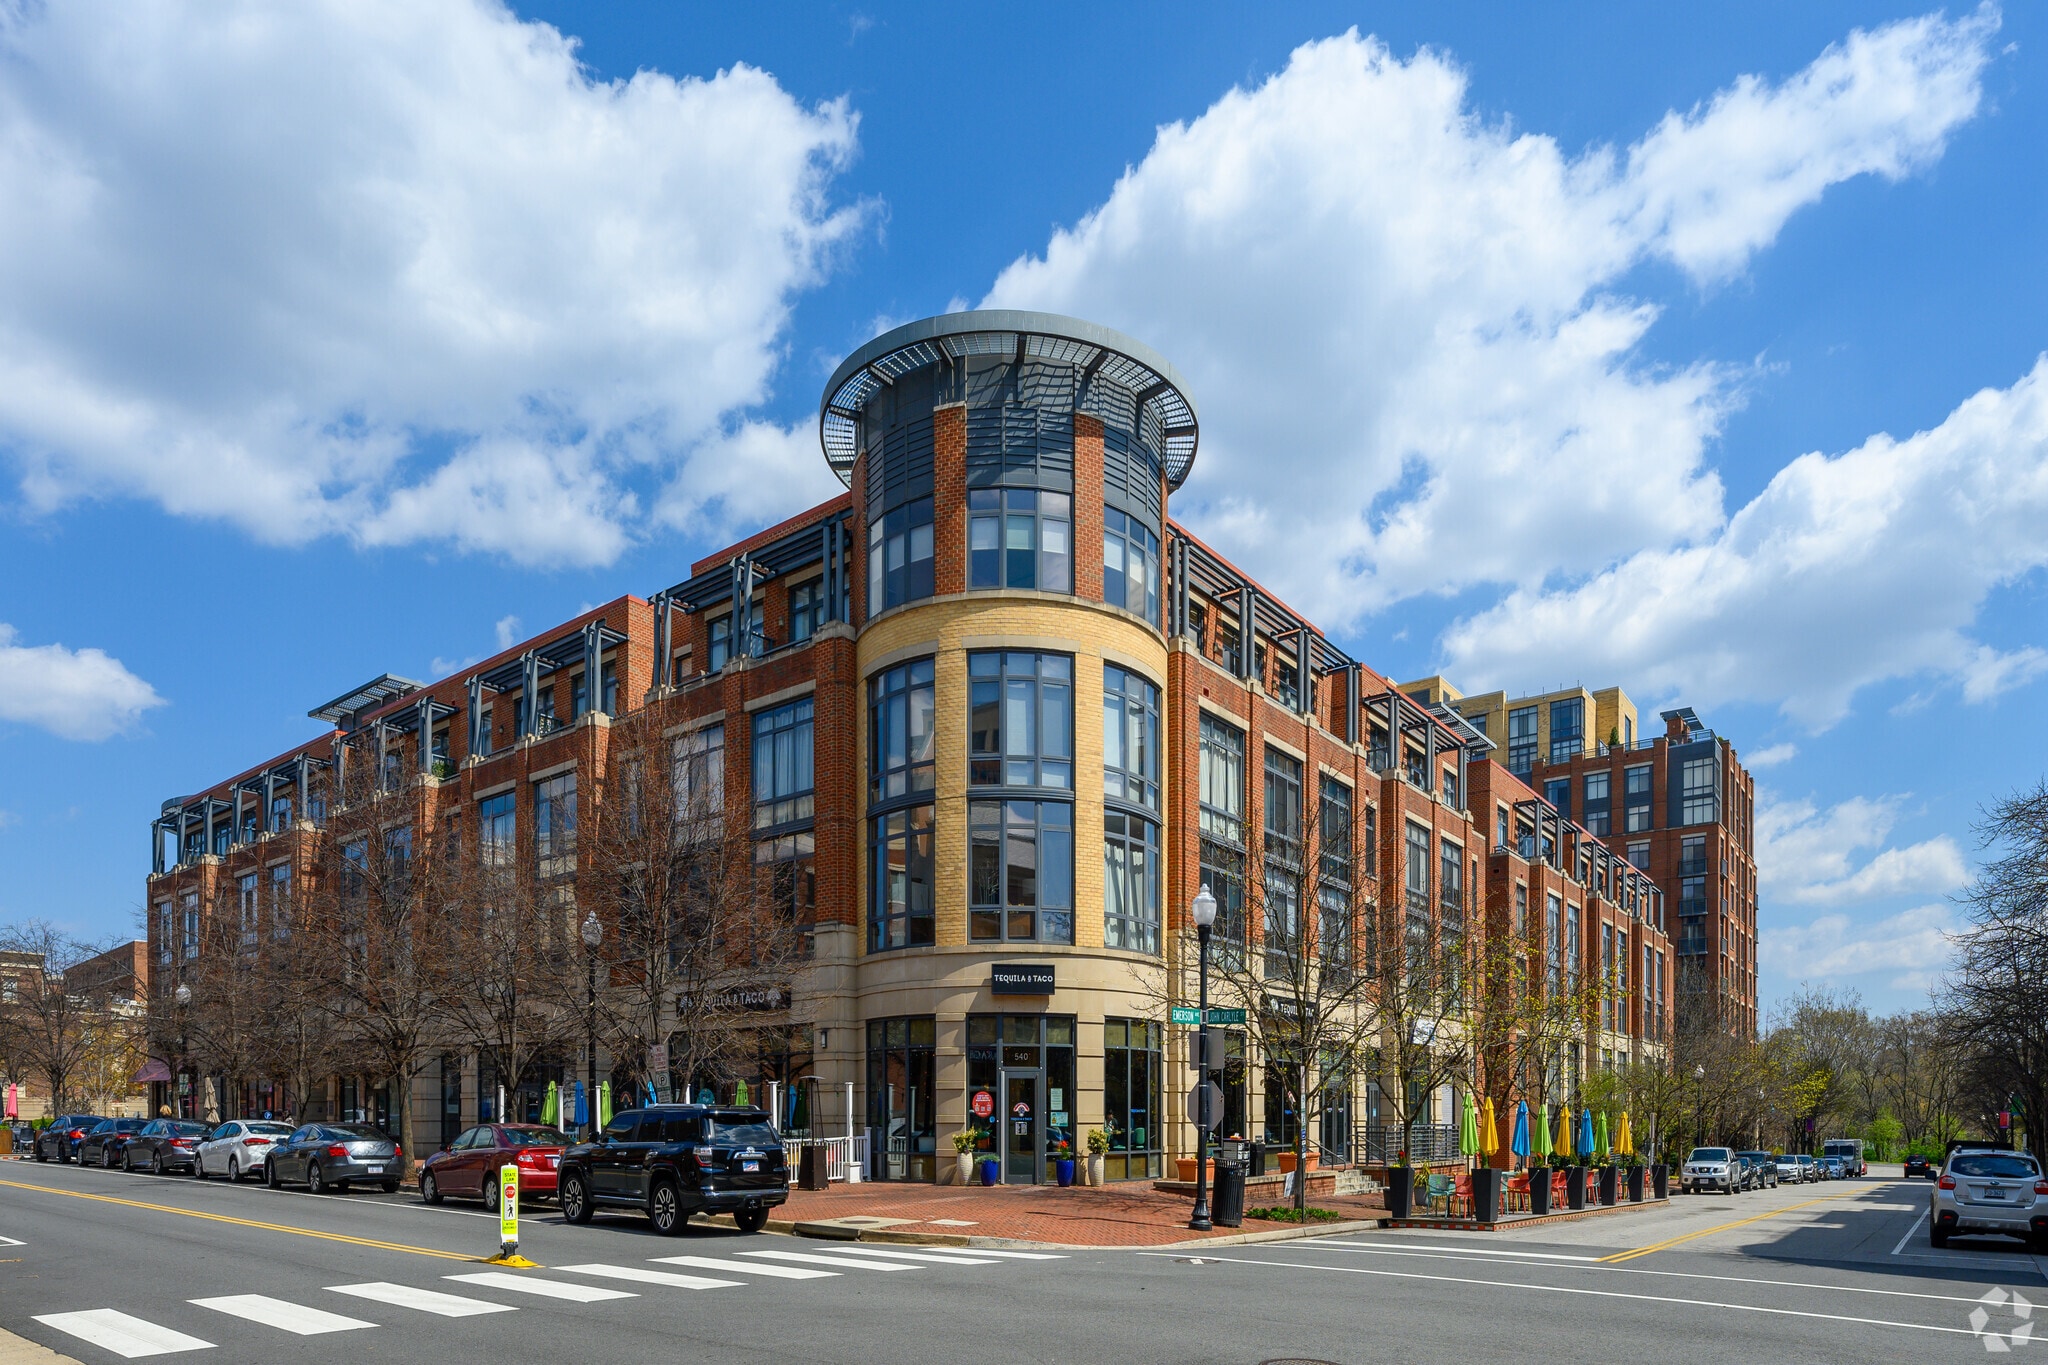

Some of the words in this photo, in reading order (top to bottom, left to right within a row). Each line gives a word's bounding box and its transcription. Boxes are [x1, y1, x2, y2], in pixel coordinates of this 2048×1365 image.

[994, 974, 1026, 984] TEQUILA
[1033, 975, 1054, 983] TACO
[740, 991, 765, 1005] TACO
[1173, 1009, 1194, 1022] EMERSON
[1209, 1011, 1220, 1022] JOHN
[1221, 1011, 1239, 1022] CARLYLE
[1014, 1053, 1029, 1061] 540
